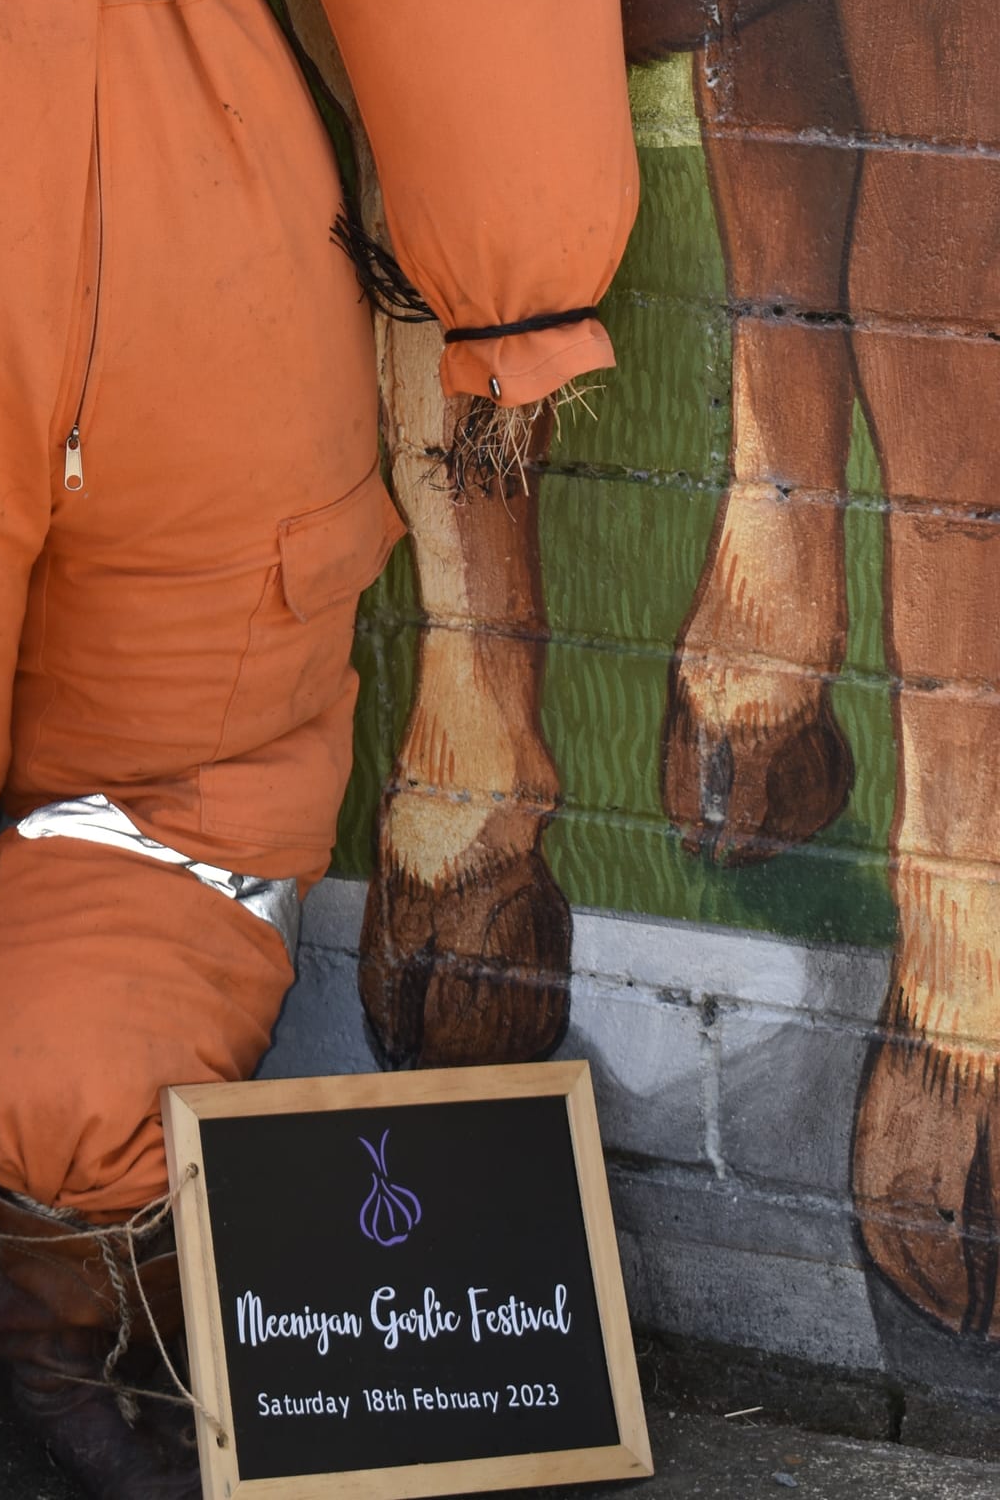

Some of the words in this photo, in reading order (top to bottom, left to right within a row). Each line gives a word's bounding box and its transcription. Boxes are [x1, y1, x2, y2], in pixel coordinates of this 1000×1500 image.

[236, 1290, 362, 1356] Meeniyan
[370, 1286, 461, 1350] Garlic
[467, 1283, 572, 1343] Festival
[257, 1390, 350, 1419] Saturday
[362, 1387, 407, 1412] 18th
[412, 1386, 499, 1413] February
[506, 1383, 559, 1407] 2023
